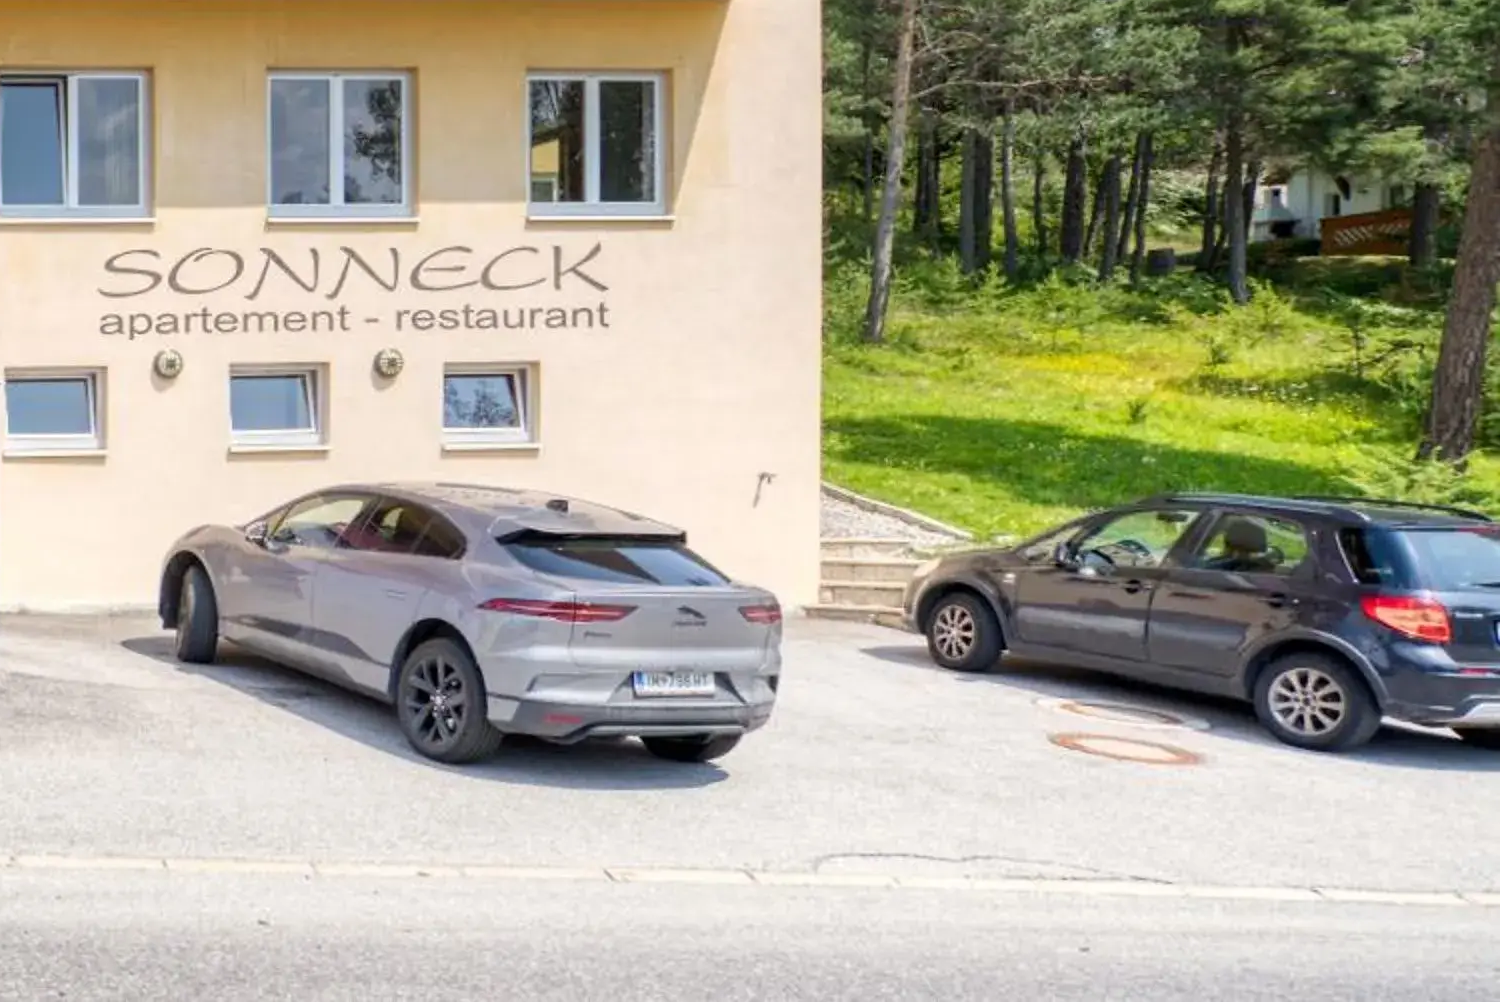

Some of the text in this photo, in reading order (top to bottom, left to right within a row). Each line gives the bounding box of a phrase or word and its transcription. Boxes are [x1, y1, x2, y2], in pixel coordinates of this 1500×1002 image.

[97, 242, 609, 300] SONNECK
[98, 305, 352, 342] apartement
[394, 301, 611, 331] restaurant
